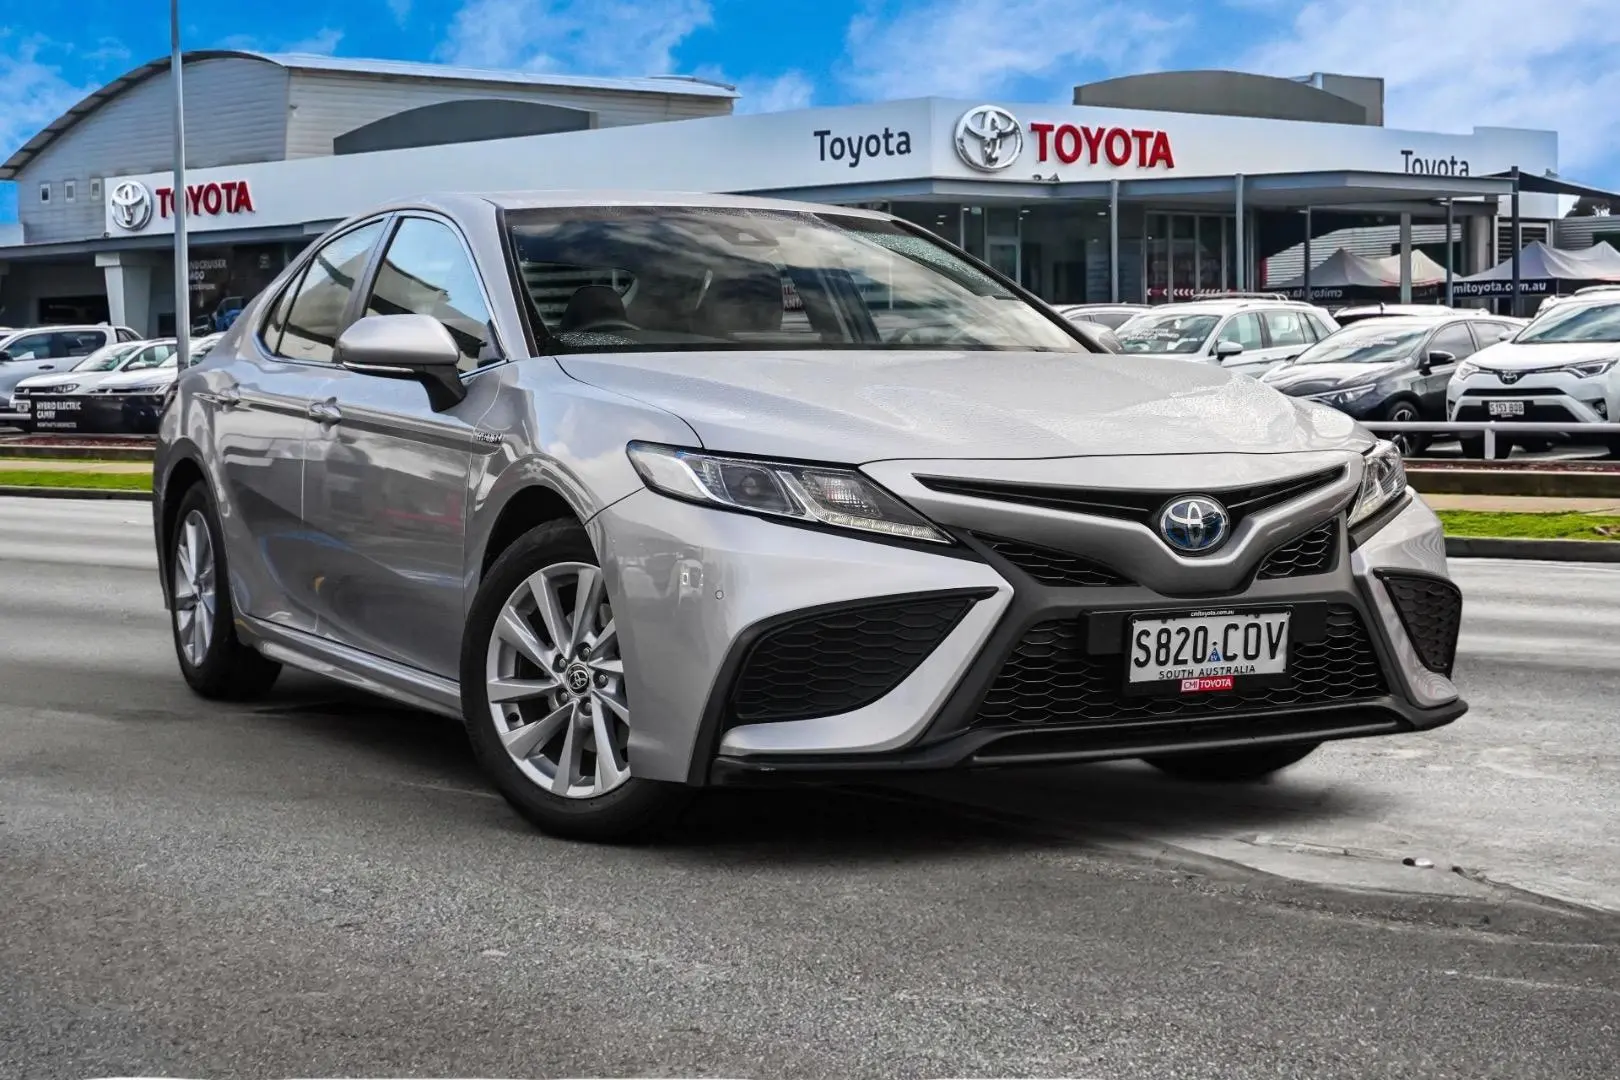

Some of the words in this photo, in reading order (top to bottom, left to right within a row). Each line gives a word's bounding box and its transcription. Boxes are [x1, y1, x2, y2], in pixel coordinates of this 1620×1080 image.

[813, 127, 912, 167] Toyota
[1030, 122, 1175, 169] TOYOTA
[1453, 281, 1547, 295] mitoyota.cm.au
[1133, 625, 1209, 668] S820
[1223, 621, 1286, 662] COV
[1159, 669, 1194, 680] SOUTH
[1198, 665, 1256, 677] AUSTRALIA
[1200, 678, 1232, 689] TOYOTA
